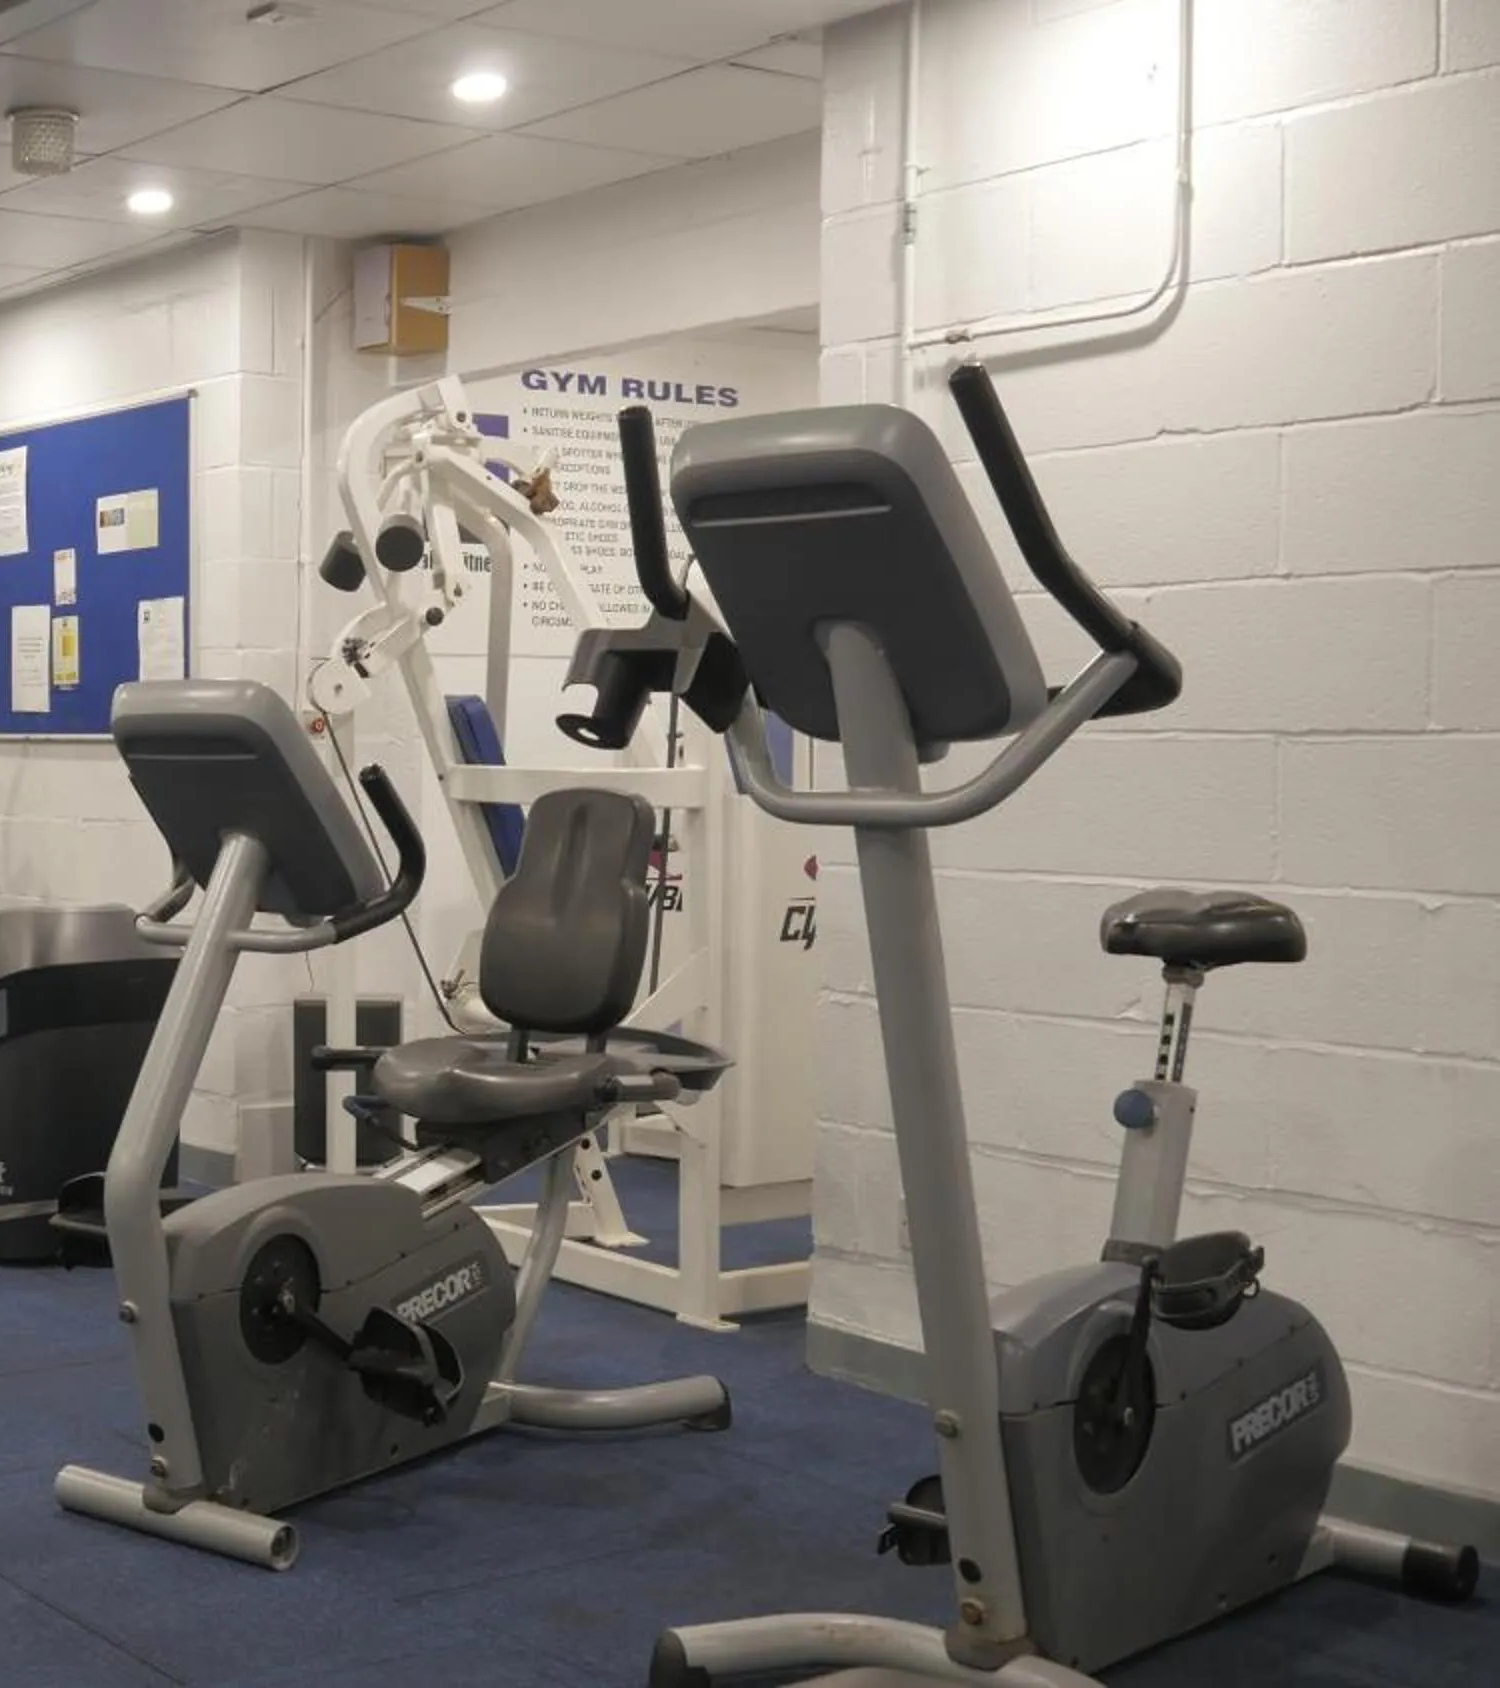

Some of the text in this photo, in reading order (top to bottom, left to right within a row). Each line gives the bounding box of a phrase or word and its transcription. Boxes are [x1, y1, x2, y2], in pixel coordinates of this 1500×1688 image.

[521, 369, 739, 408] GYM RULES
[396, 1267, 472, 1322] PRECOR
[1231, 1379, 1310, 1453] PRECOR
